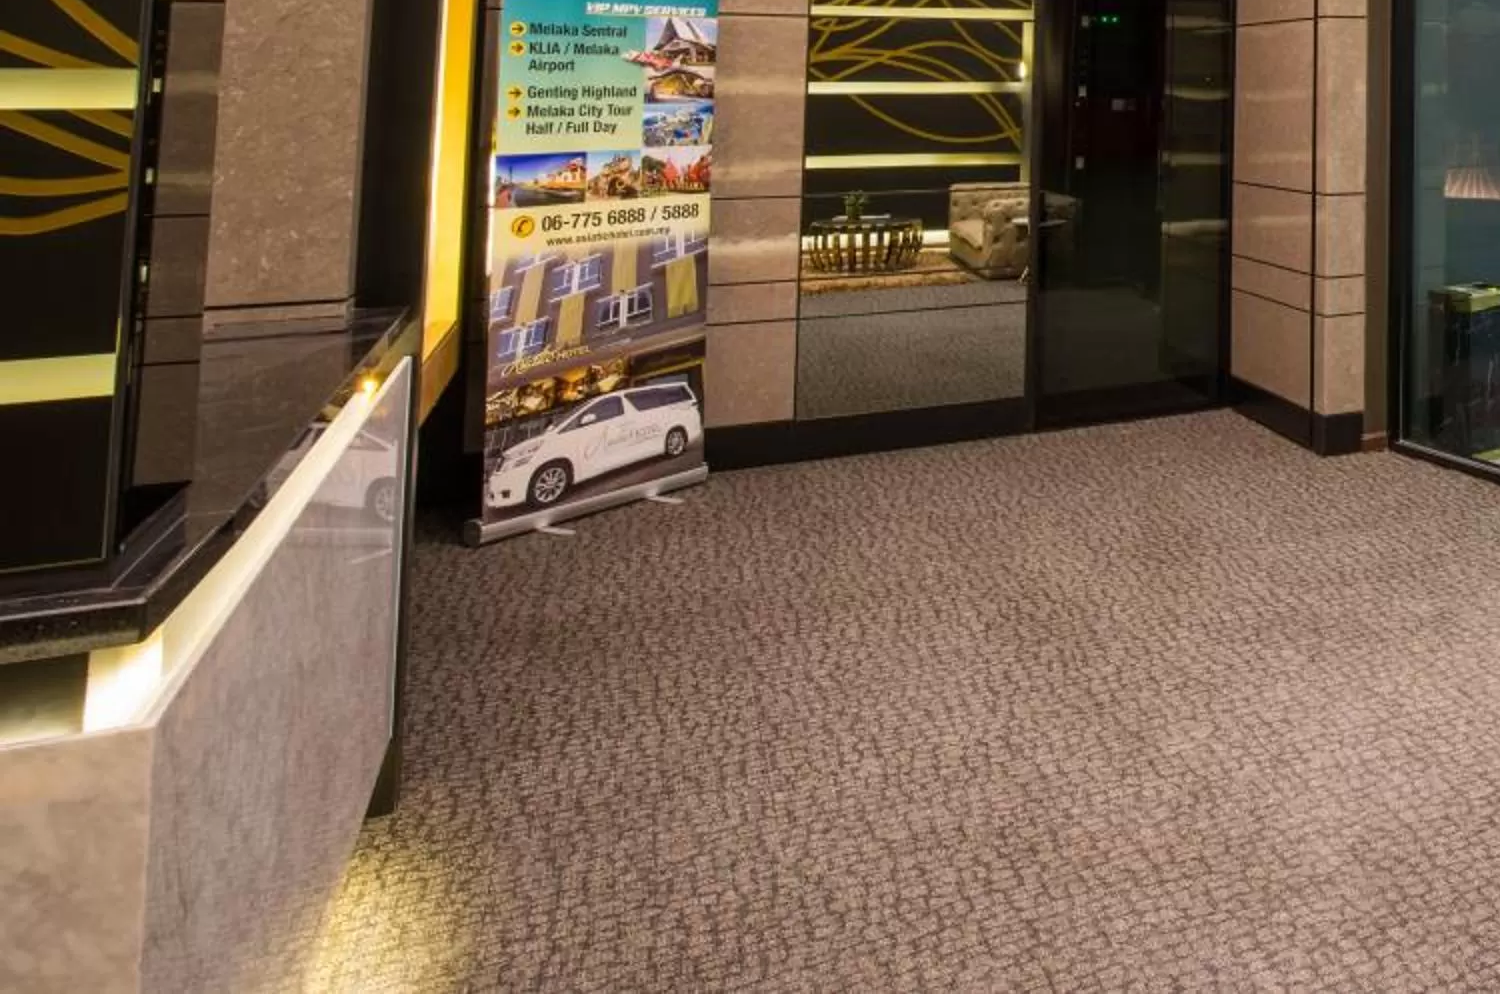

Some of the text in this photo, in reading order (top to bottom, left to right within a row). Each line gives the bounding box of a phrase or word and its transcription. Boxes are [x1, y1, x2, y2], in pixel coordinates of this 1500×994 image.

[528, 23, 627, 38] Melaka Sentral
[528, 41, 560, 55] KLIA
[573, 43, 619, 55] Melaka
[528, 59, 575, 73] Airport
[527, 86, 637, 100] Genting Highland
[527, 104, 633, 118] Melaka City Tour
[526, 122, 553, 135] Half
[565, 121, 588, 134] Full
[593, 120, 617, 134] Day
[541, 211, 602, 232] 06-775
[607, 208, 645, 226] 6888
[661, 203, 700, 221] 5888
